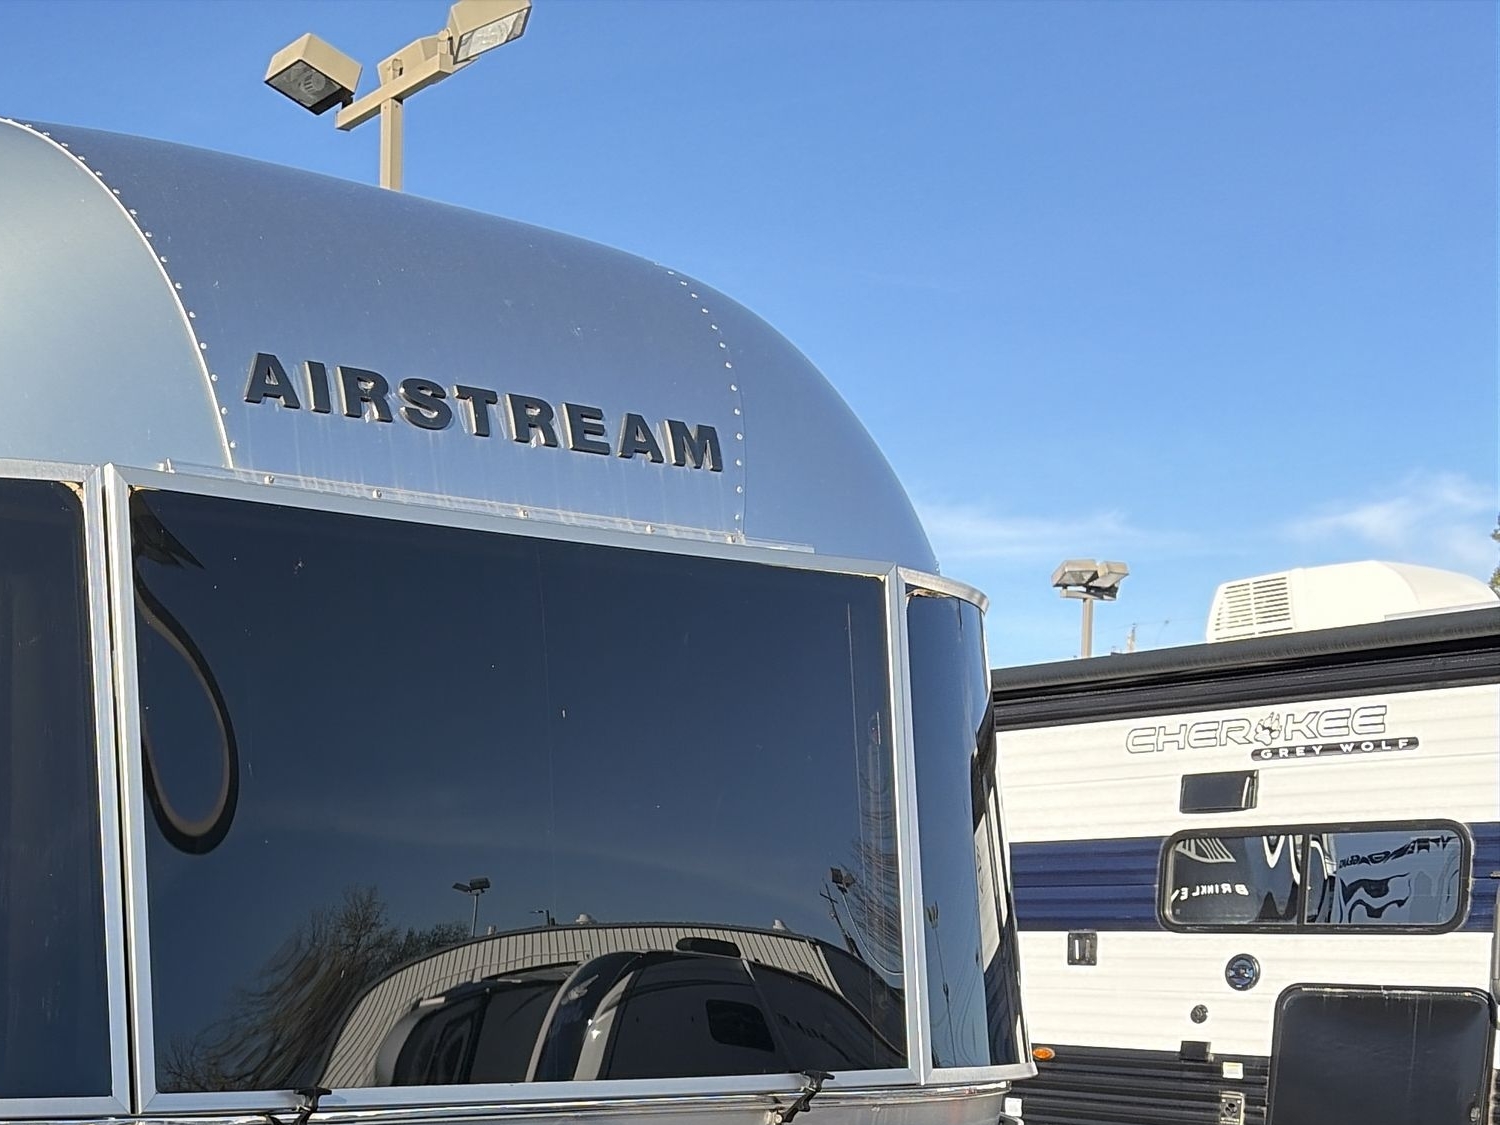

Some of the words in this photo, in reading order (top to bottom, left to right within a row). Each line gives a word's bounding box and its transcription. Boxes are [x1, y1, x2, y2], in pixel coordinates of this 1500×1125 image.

[243, 352, 723, 472] AIRSTREAM
[1260, 745, 1323, 759] GREY
[1340, 738, 1409, 753] WOLF
